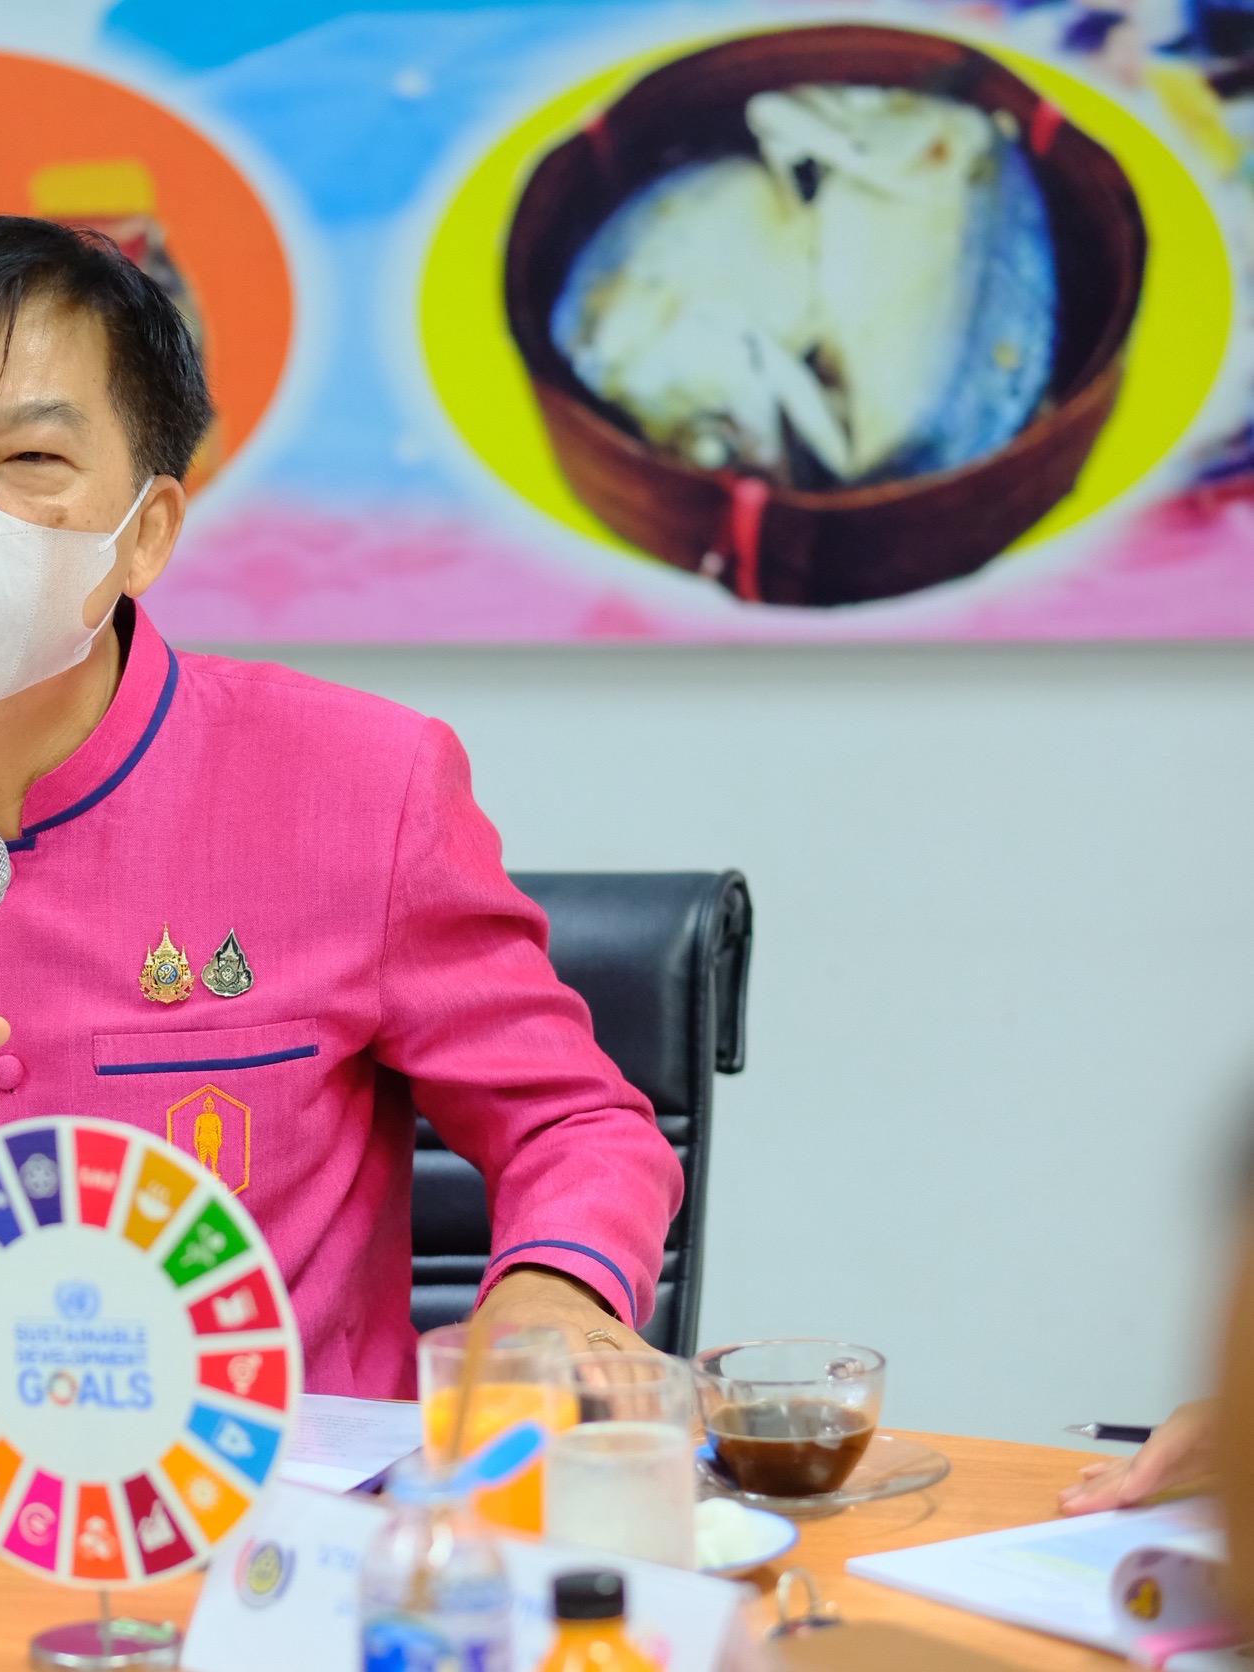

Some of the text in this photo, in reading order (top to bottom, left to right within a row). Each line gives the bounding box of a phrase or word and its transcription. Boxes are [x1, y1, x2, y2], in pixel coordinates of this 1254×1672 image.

[15, 1323, 147, 1343] SUSTAINABLE
[15, 1346, 147, 1364] DEVELOPMENT
[17, 1368, 154, 1410] GOALS
